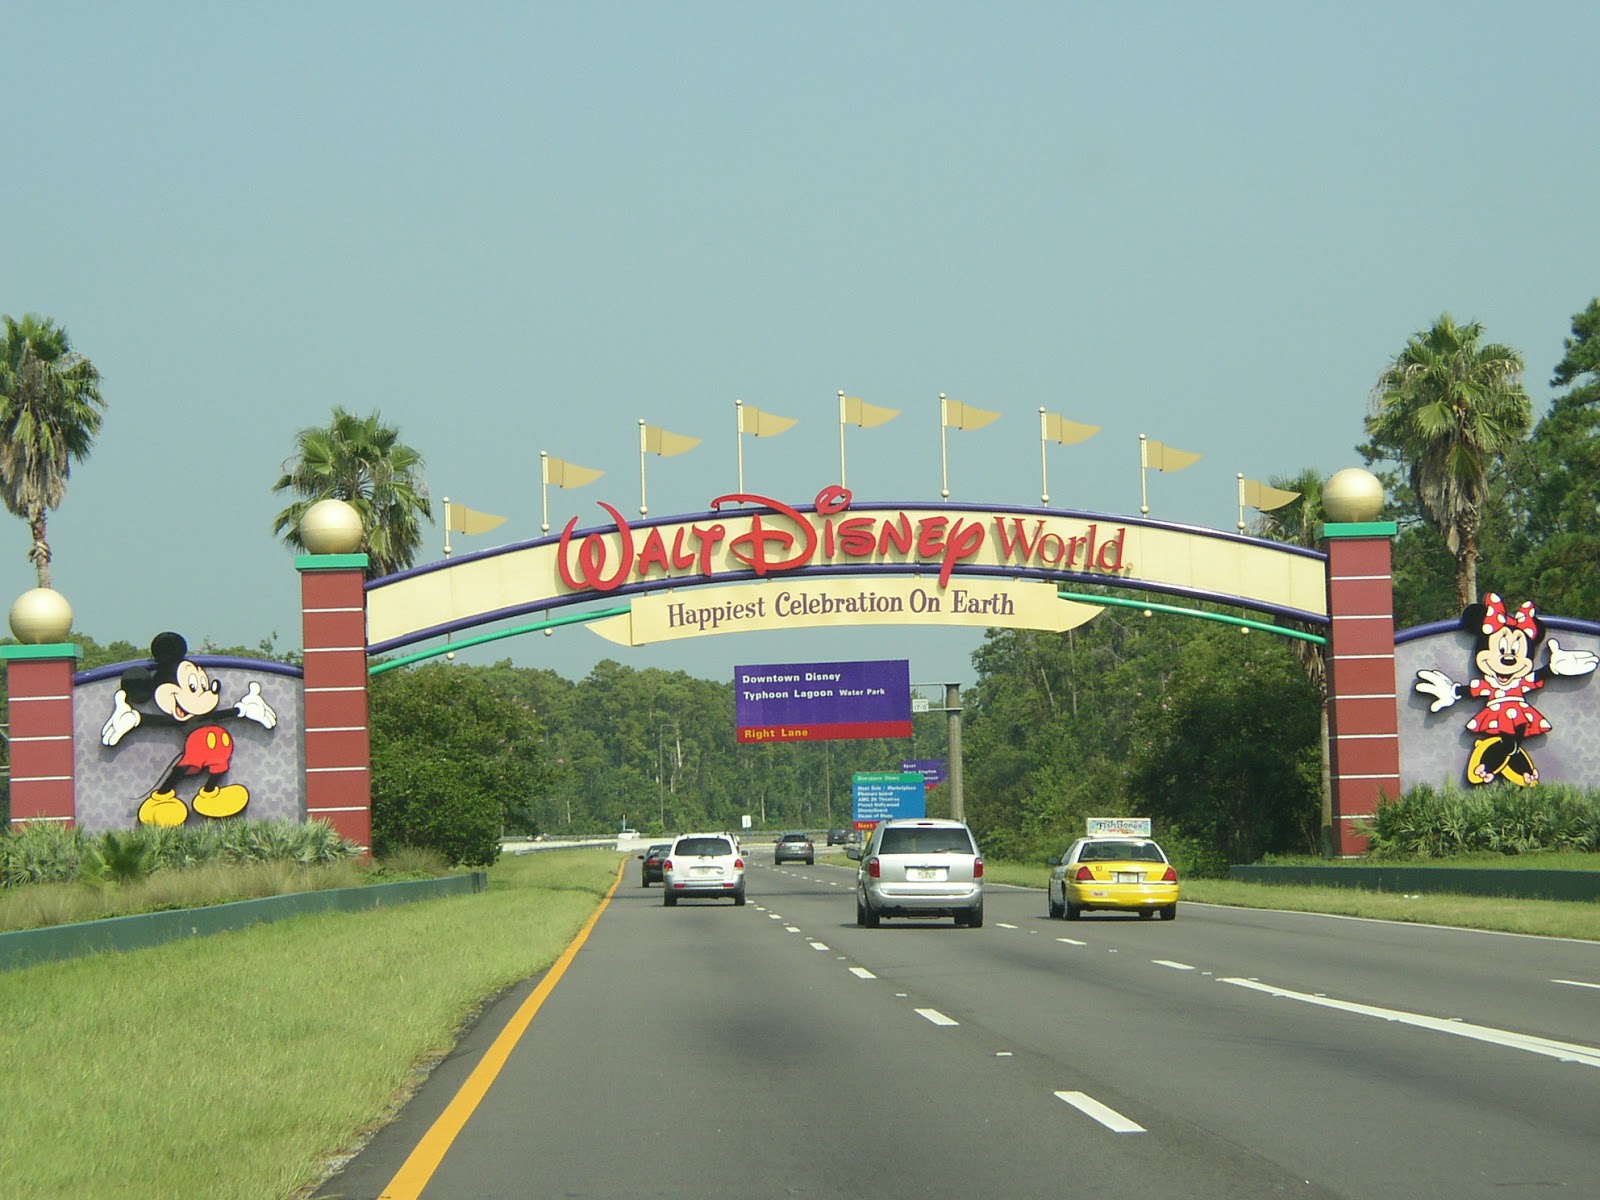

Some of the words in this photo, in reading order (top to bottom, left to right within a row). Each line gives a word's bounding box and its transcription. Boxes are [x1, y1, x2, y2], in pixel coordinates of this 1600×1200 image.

[993, 516, 1127, 571] World
[667, 597, 767, 631] Happiest
[775, 591, 904, 618] Celebration
[909, 588, 941, 614] On
[951, 589, 1015, 616] Earth
[742, 673, 800, 684] Downtown
[805, 672, 841, 683] Disney
[743, 690, 789, 701] Typhoon
[794, 689, 833, 700] Lagoon
[839, 688, 864, 697] Water
[867, 687, 885, 696] Park
[744, 728, 775, 739] Right
[781, 728, 808, 738] Lane
